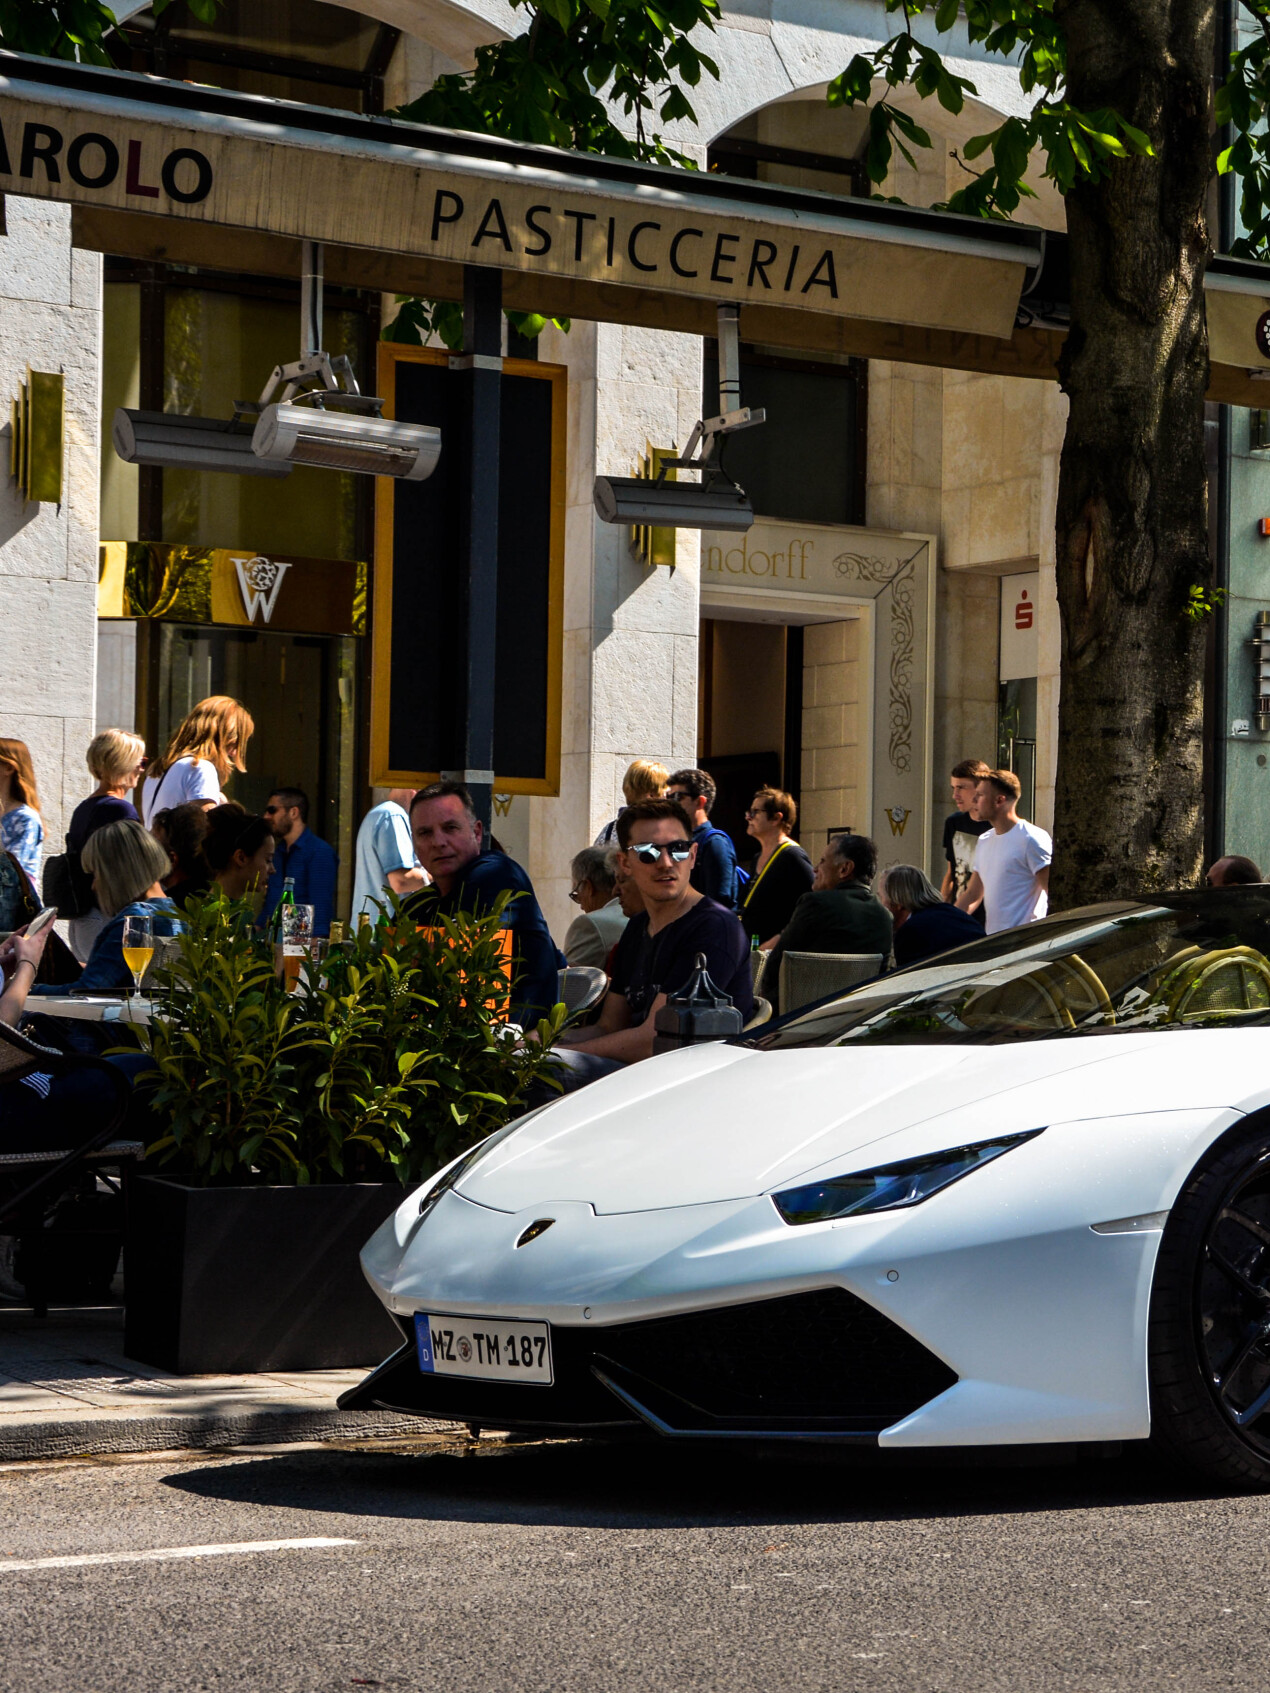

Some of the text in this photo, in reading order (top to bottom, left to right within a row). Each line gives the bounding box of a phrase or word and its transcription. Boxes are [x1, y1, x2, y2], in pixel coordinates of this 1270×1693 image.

[0, 117, 213, 204] ROLO
[430, 189, 840, 299] PASTICCERIA
[430, 1329, 457, 1362] MZ
[472, 1332, 501, 1366] TM
[506, 1334, 547, 1368] 187
